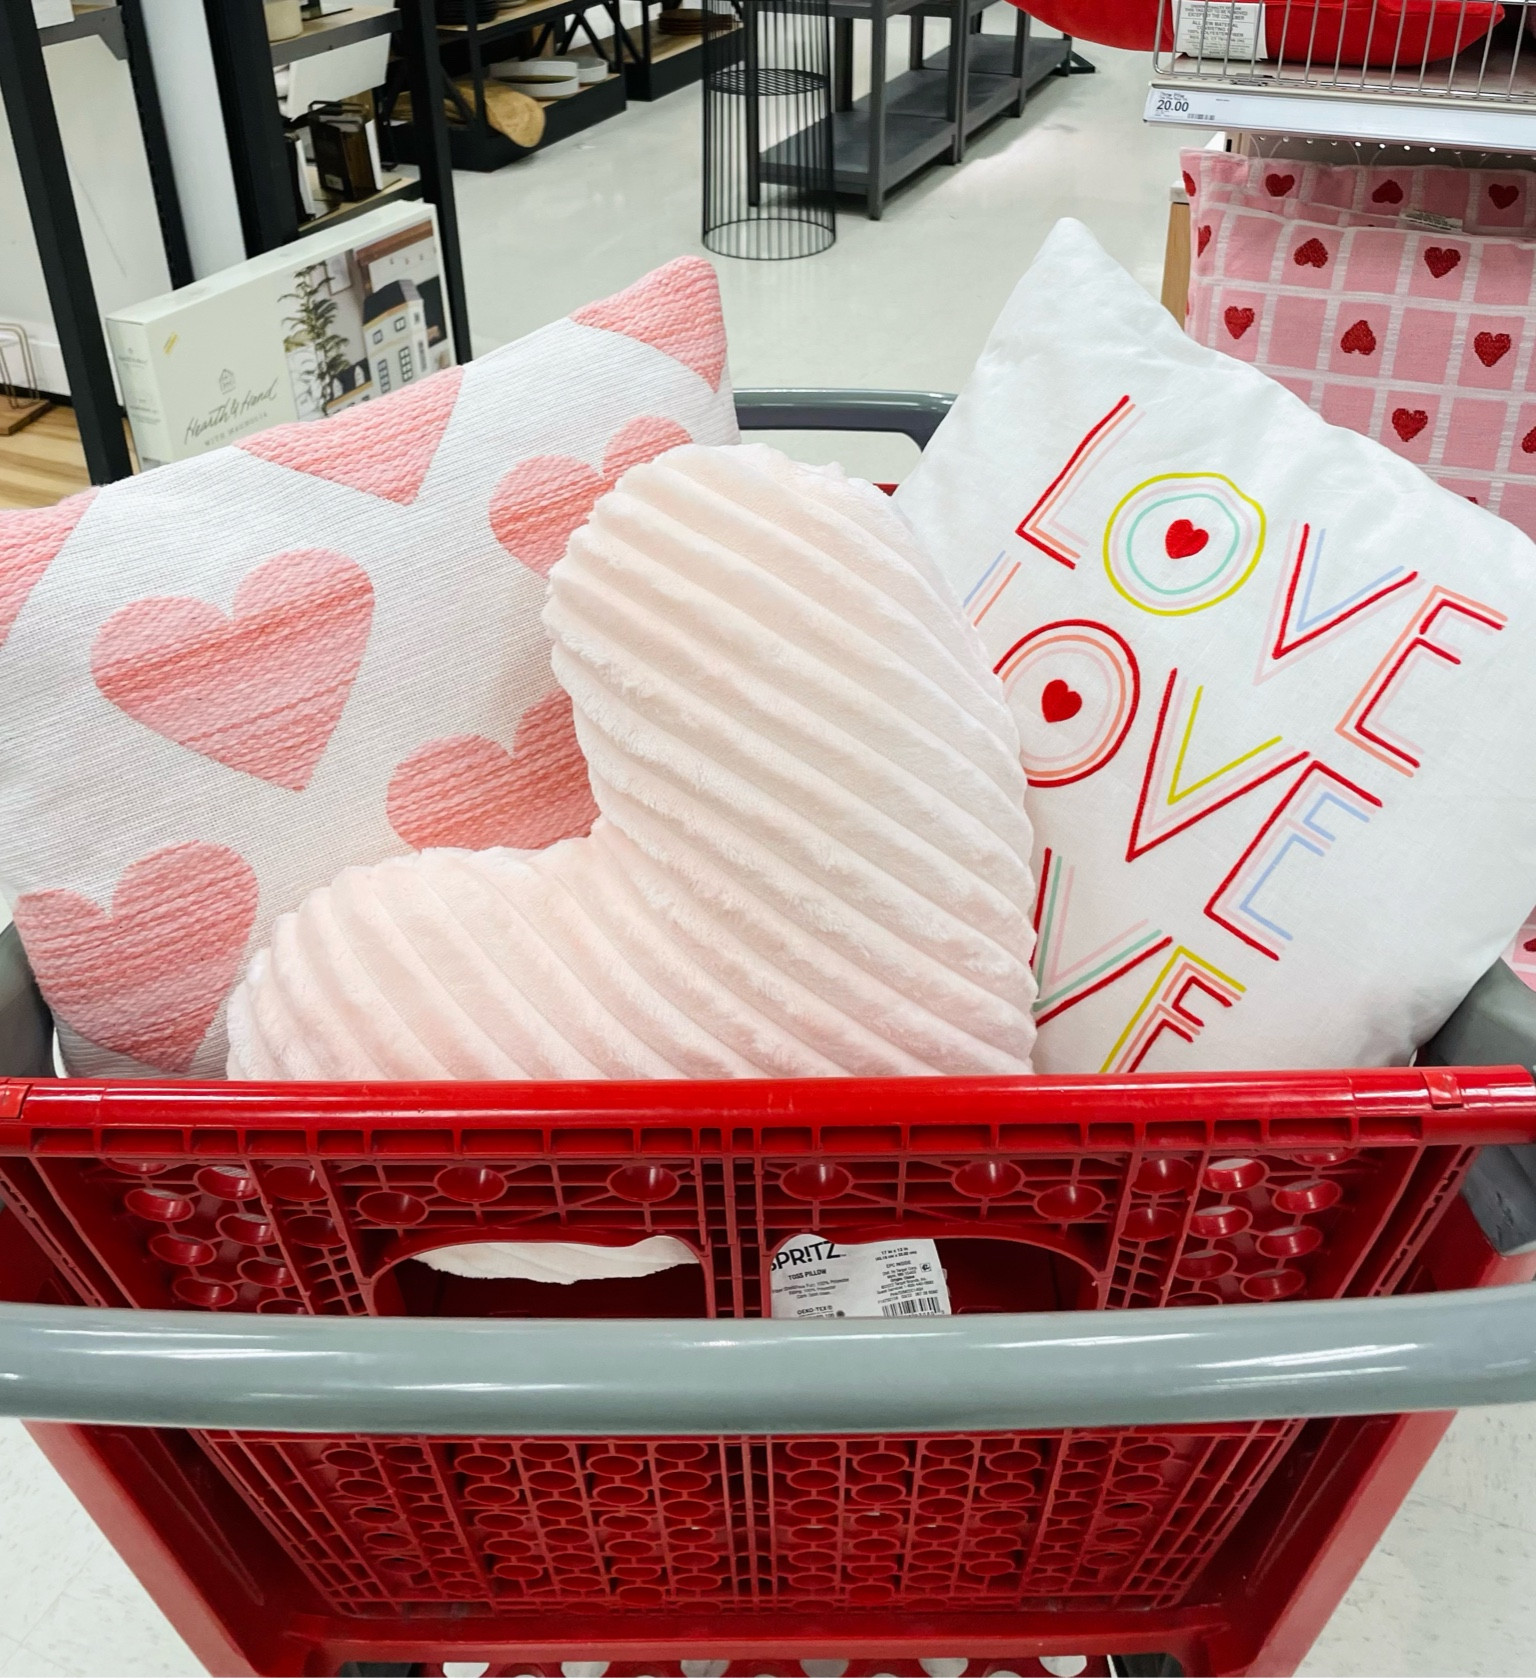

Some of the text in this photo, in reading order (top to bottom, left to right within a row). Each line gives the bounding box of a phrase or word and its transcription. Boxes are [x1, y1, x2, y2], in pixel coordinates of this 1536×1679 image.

[1157, 99, 1189, 112] 20.00
[184, 398, 231, 445] Hearth
[240, 377, 278, 415] Hand
[1015, 394, 1508, 779] LOVE
[788, 1269, 827, 1280] TOSS PILLOW
